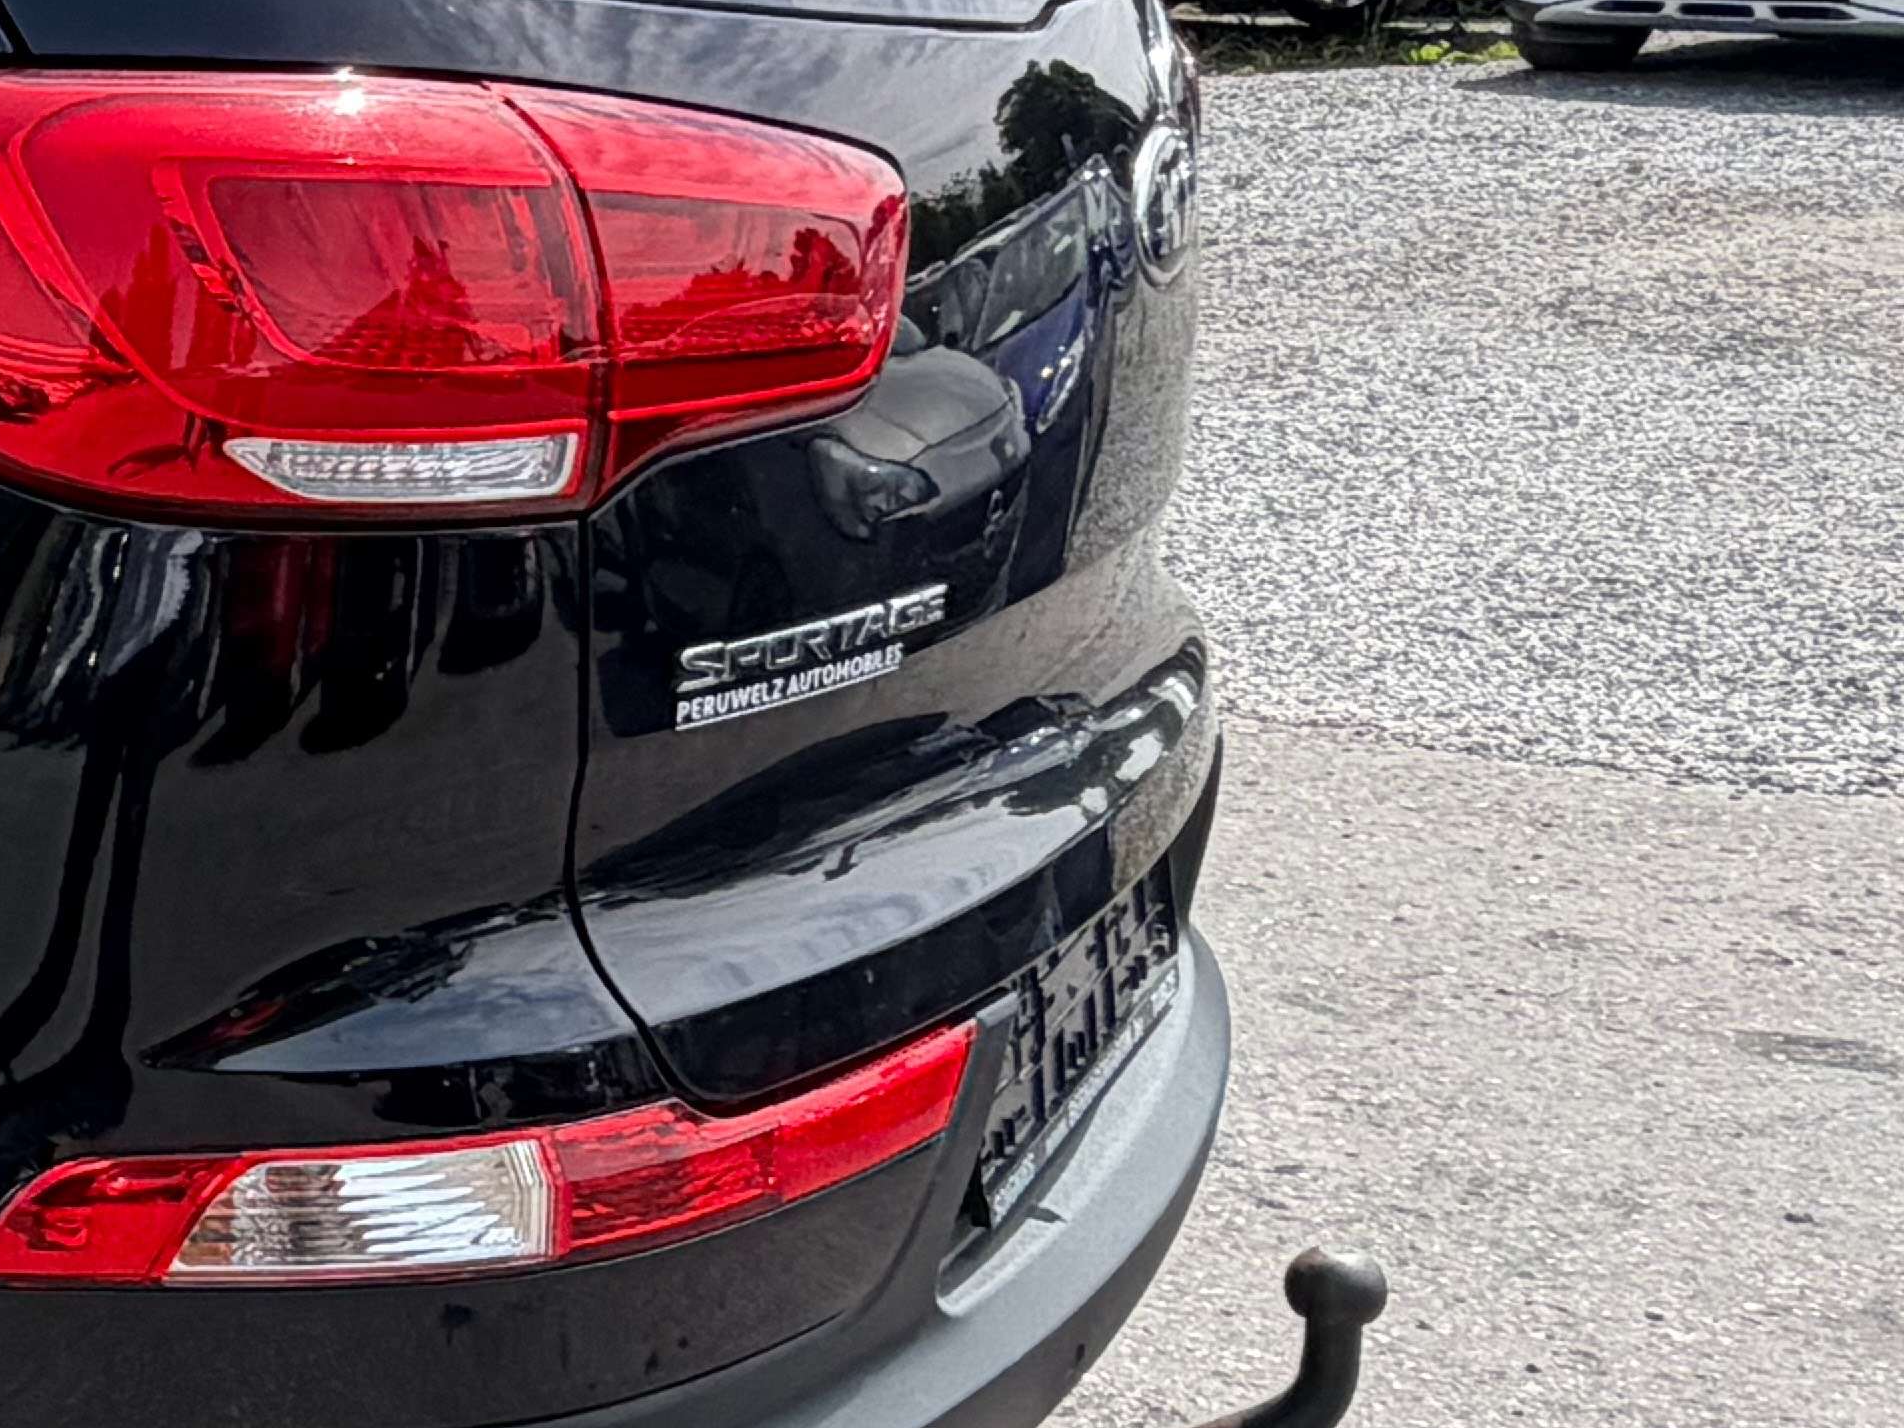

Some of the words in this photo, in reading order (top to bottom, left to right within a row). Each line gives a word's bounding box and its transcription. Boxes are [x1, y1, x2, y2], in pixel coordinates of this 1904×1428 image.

[676, 583, 949, 693] SPORTAGE
[676, 677, 785, 724] PERUWELZ
[786, 642, 904, 697] AUTOMOBILES
